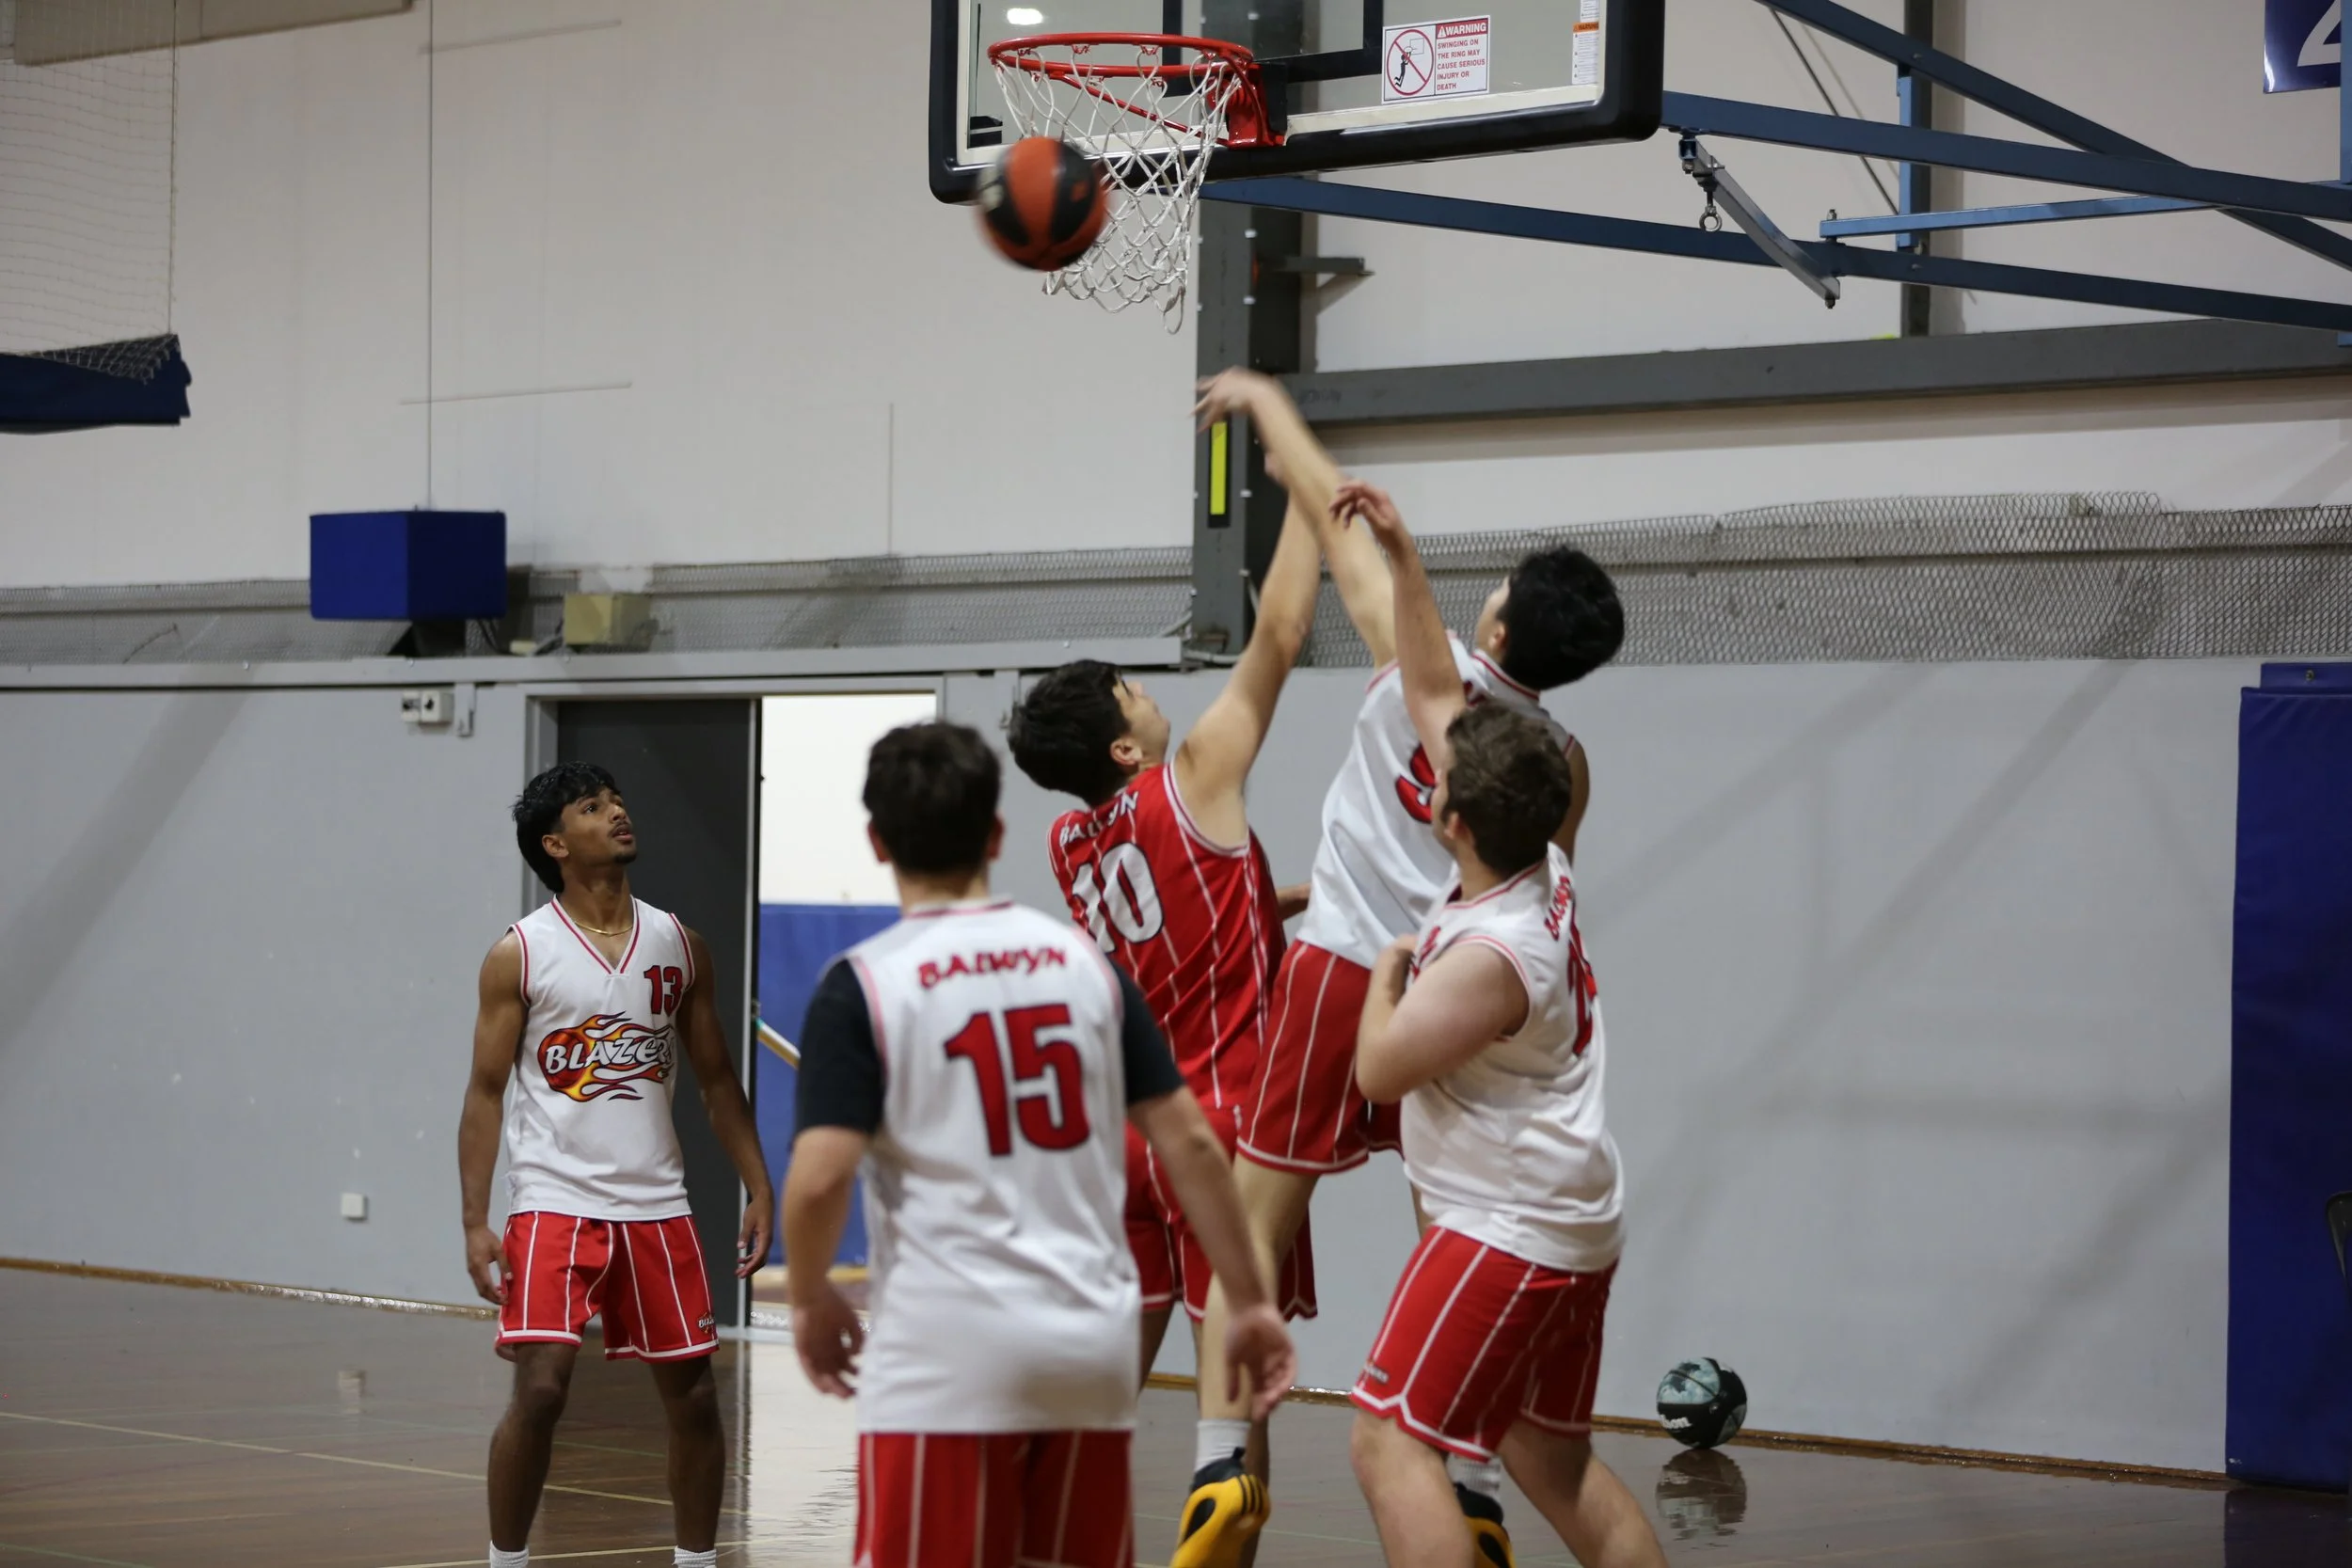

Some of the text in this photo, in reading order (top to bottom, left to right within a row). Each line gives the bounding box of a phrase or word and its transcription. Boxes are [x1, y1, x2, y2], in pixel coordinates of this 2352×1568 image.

[1445, 23, 1486, 36] WARNING
[1438, 40, 1468, 49] SWINGING
[1437, 59, 1486, 70] CAUSE SERIOUS
[1437, 71, 1459, 80] INJURY
[1072, 842, 1164, 954] 10
[644, 965, 683, 1017] 13
[944, 1003, 1091, 1159] 15
